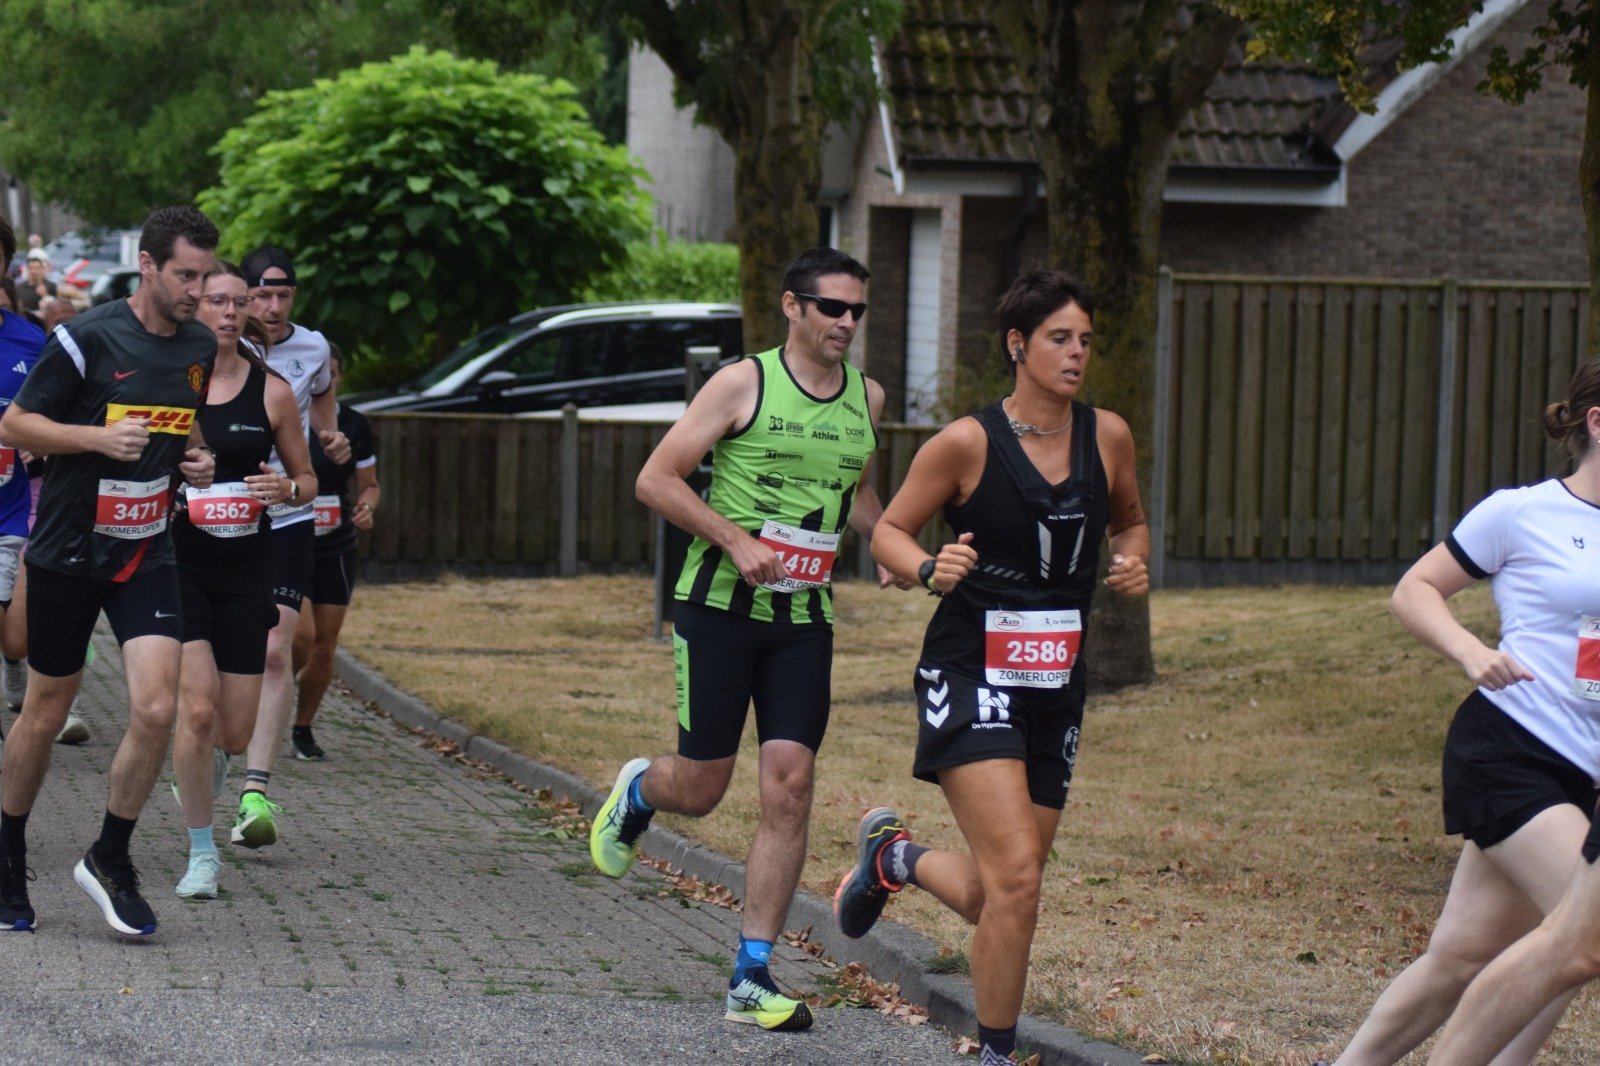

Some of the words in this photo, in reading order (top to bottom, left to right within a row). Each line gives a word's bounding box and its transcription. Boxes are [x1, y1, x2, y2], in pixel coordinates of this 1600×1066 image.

[811, 431, 839, 441] Athlex
[113, 501, 158, 520] 3471
[203, 503, 250, 519] 2562
[105, 521, 160, 534] ZOMERLOPEN
[775, 551, 822, 576] 1418
[776, 578, 820, 590] ERLOPEN
[1007, 640, 1068, 663] 2586
